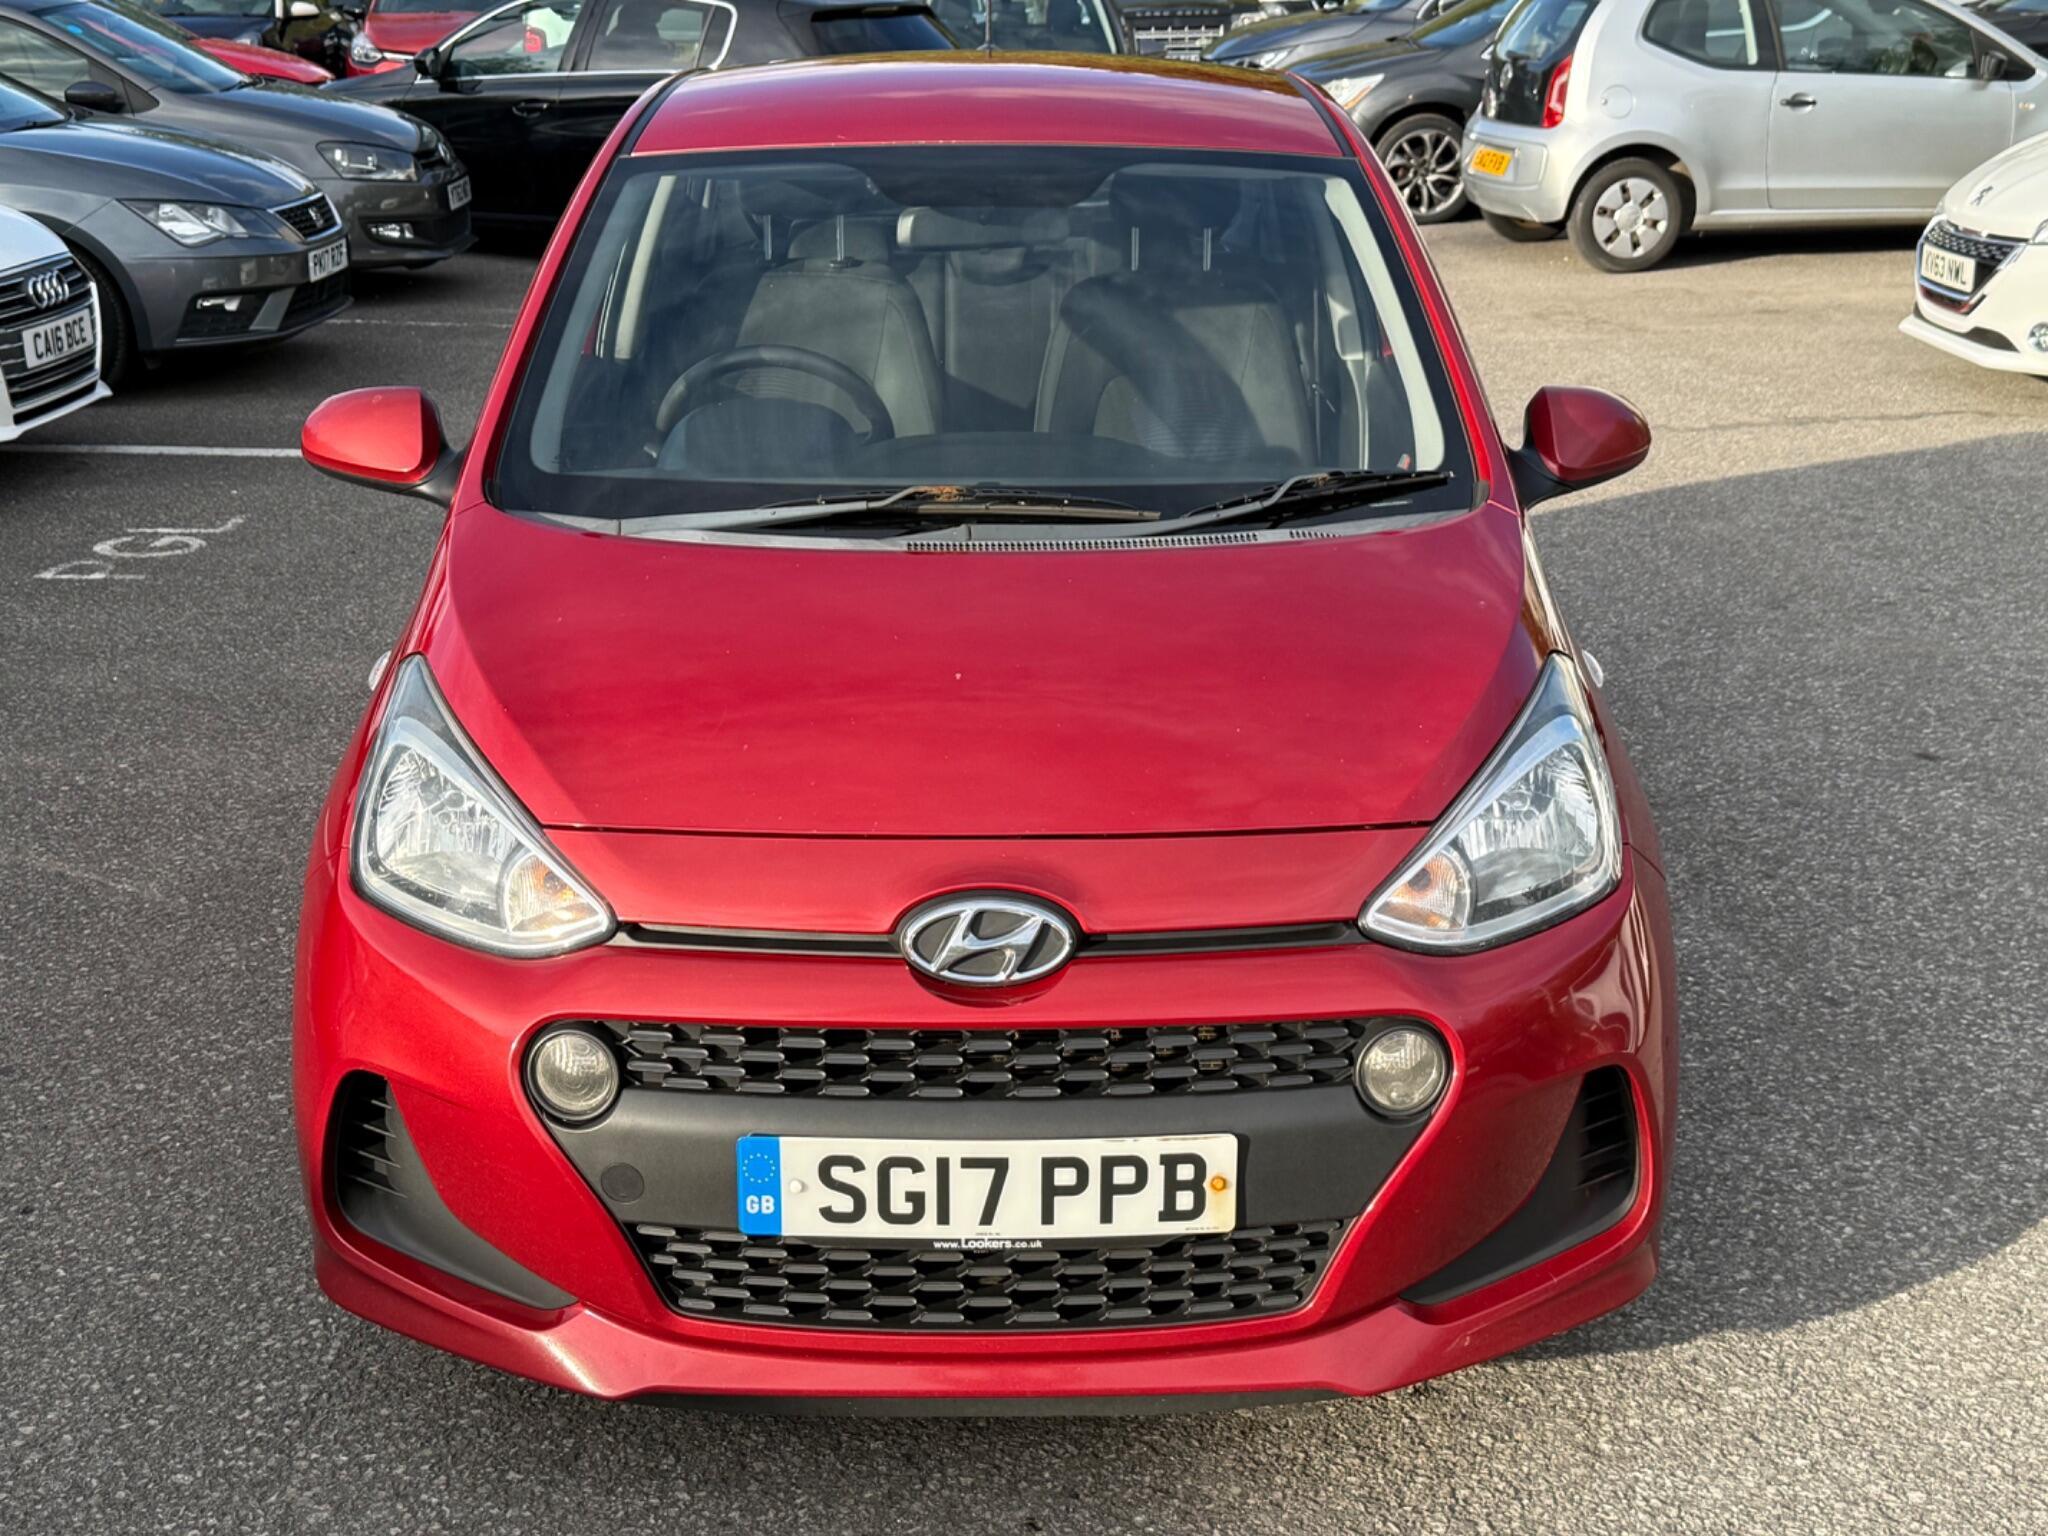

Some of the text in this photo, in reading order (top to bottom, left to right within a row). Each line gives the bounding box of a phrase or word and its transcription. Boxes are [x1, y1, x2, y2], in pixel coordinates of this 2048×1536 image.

[33, 316, 87, 359] CA16 BCE
[746, 1194, 775, 1215] GB
[817, 1152, 1207, 1226] SG17 PPB
[933, 1237, 1043, 1249] www.Lookers.co.uk
